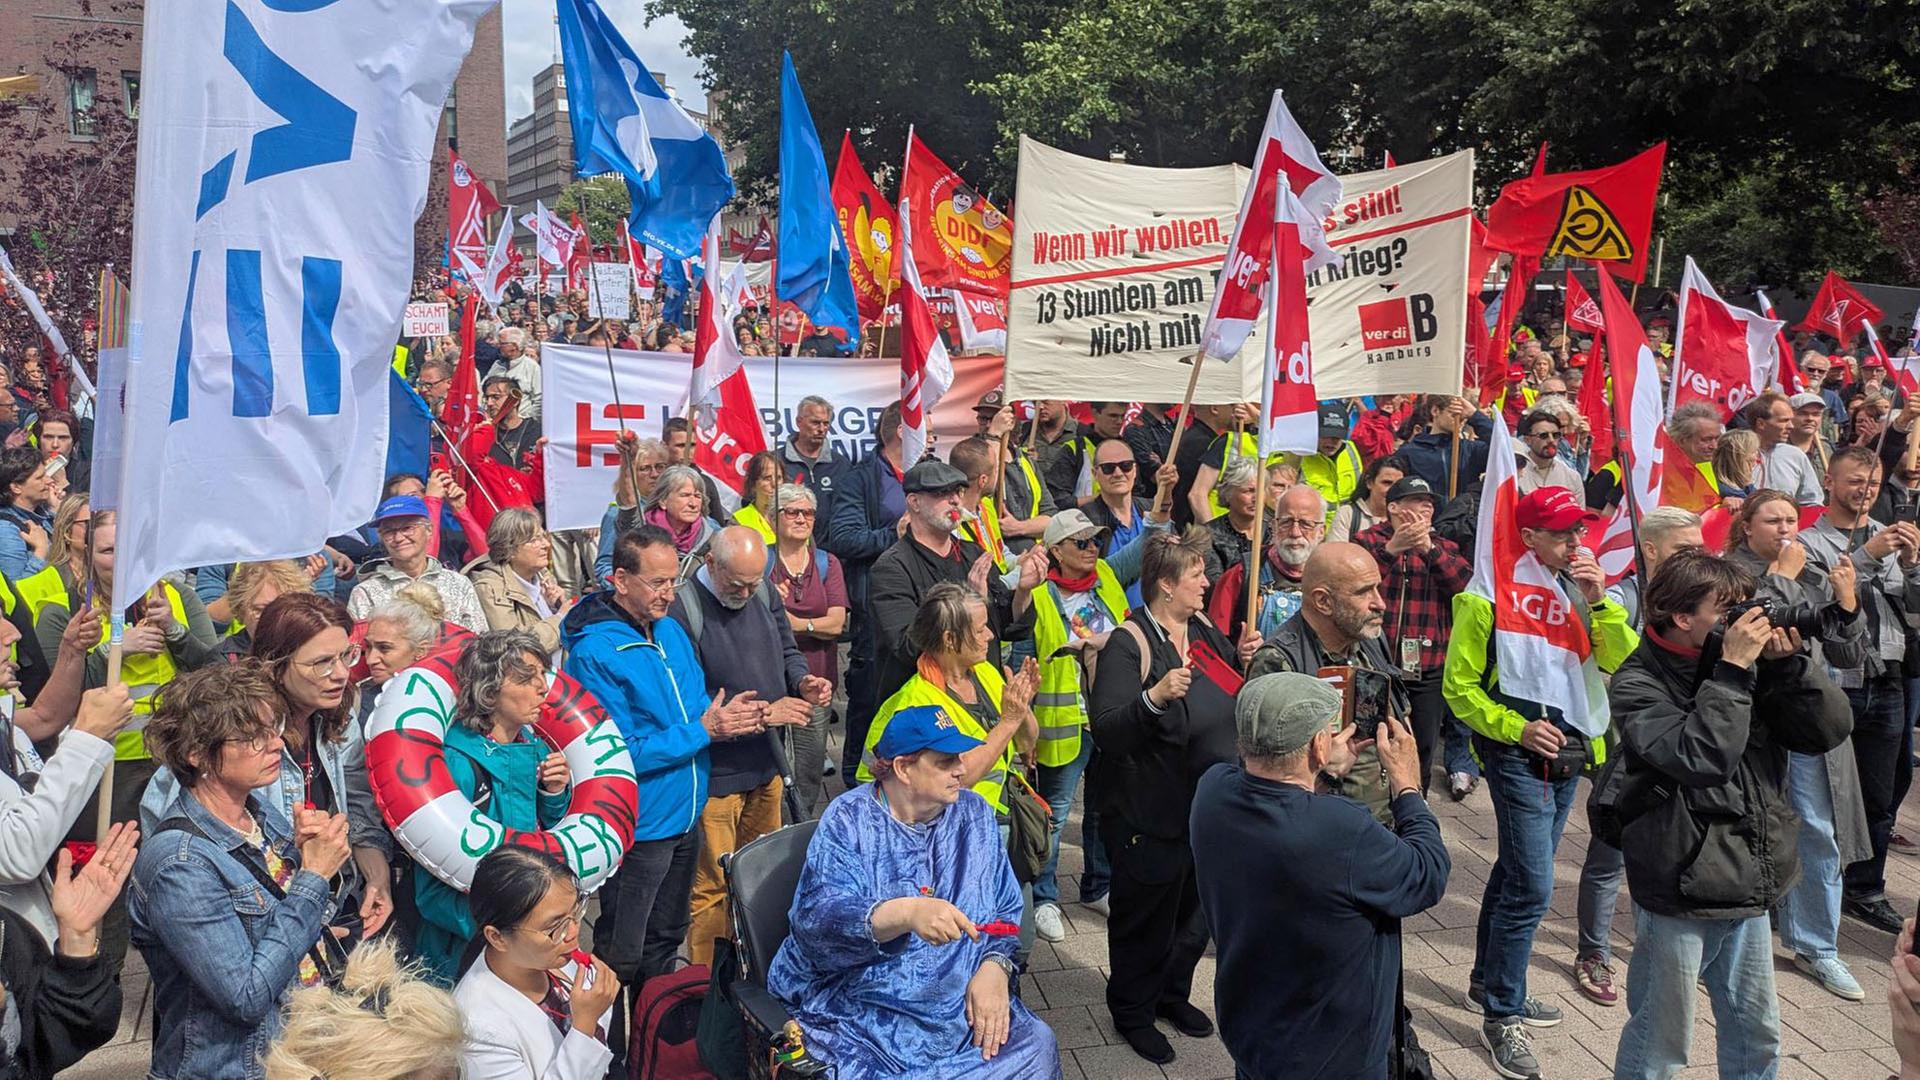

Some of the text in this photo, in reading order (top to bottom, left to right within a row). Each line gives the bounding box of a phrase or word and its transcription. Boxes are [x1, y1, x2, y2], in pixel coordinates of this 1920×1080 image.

[1033, 231, 1086, 265] Wenn
[1092, 224, 1128, 258] wir
[1135, 216, 1228, 253] wollen,
[1343, 185, 1403, 226] still!
[1036, 291, 1057, 324] 13
[1063, 281, 1156, 321] Stunden
[1164, 275, 1204, 307] am
[1410, 292, 1438, 343] B
[413, 321, 444, 335] EUCH!
[1090, 313, 1202, 357] Nicht mit
[1367, 345, 1432, 365] Hamburg
